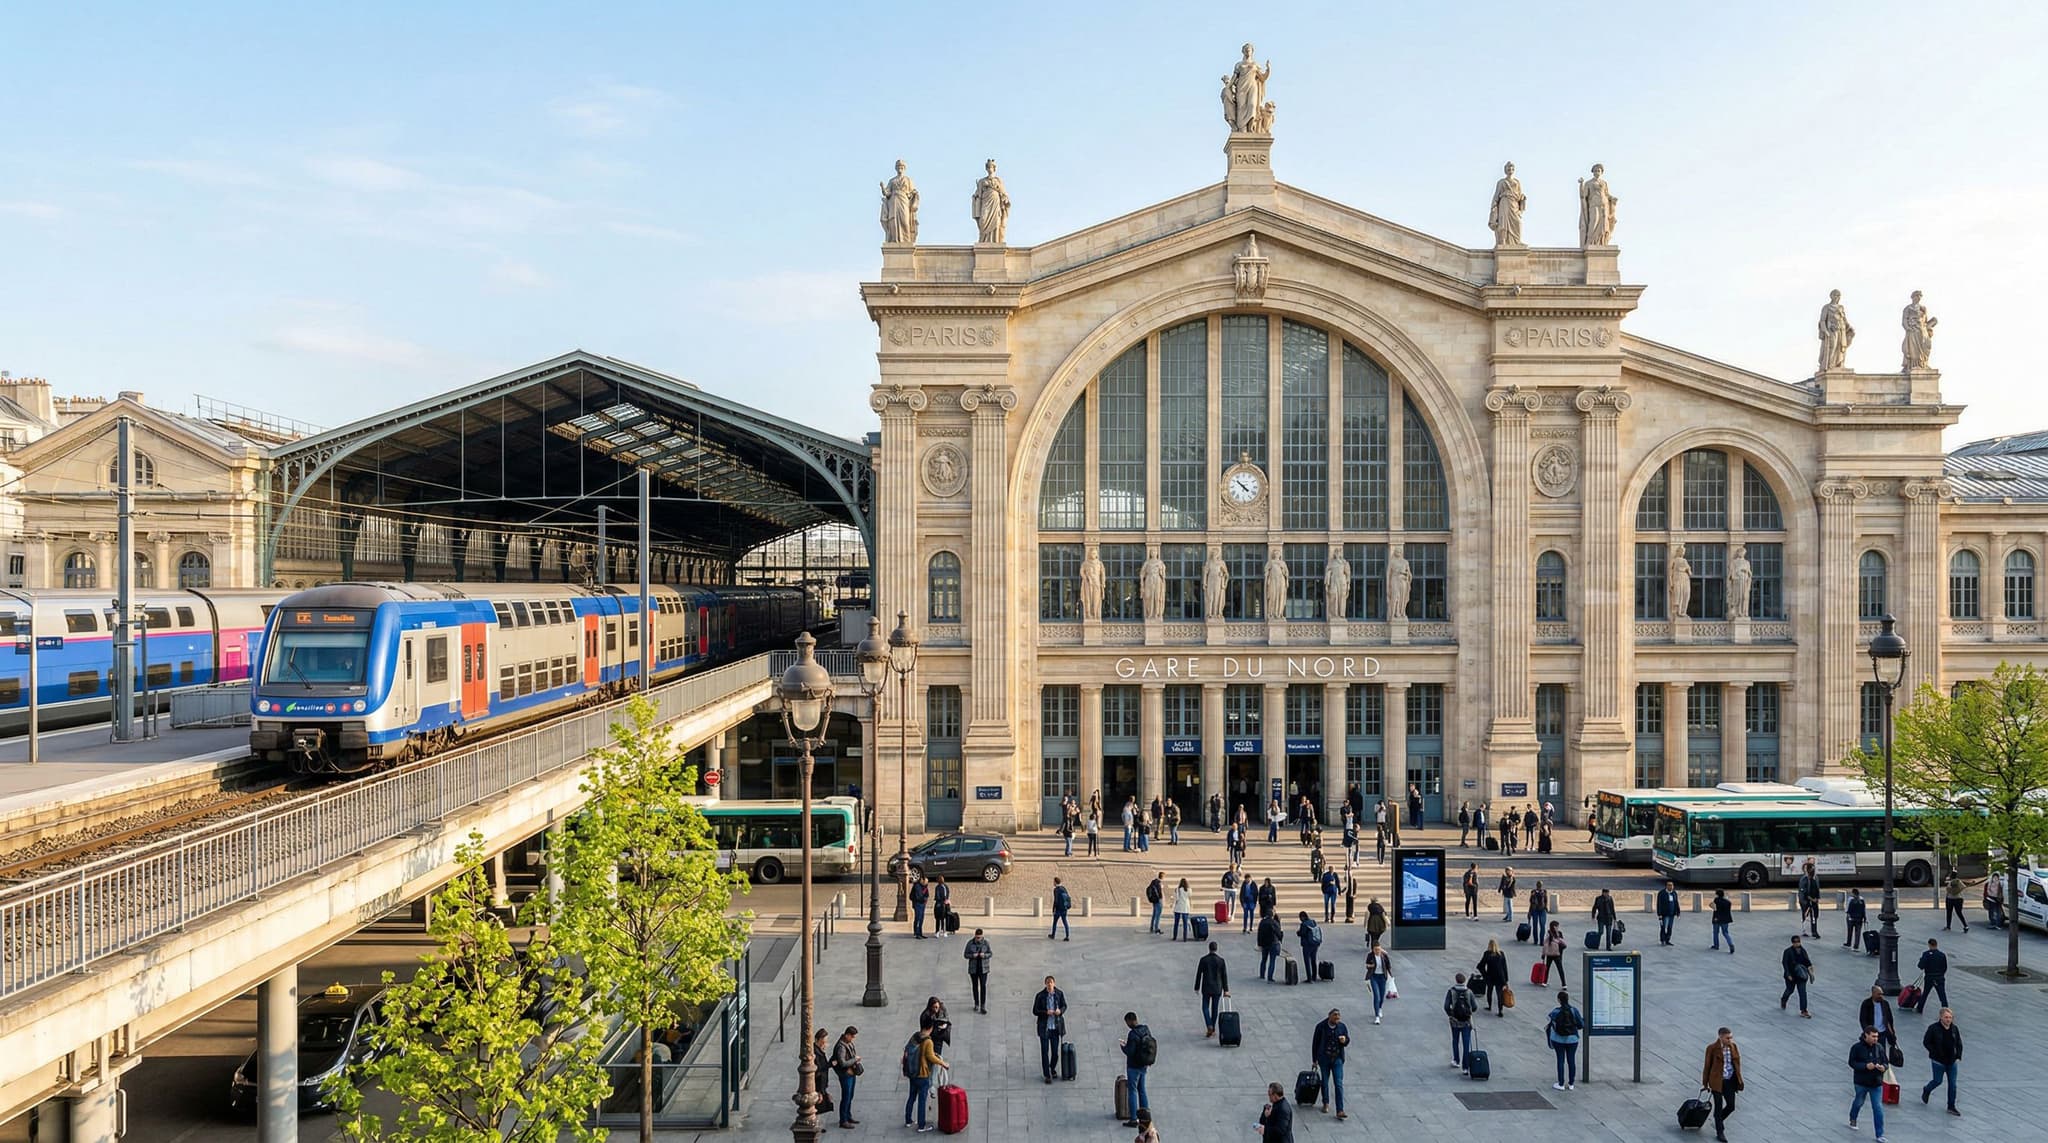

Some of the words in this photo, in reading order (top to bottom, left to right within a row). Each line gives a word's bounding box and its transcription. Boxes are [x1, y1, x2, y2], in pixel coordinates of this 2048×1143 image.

[1234, 153, 1267, 165] PARIS
[910, 326, 977, 346] PARIS
[1525, 327, 1592, 348] PARIS
[1115, 657, 1200, 678] GARE
[1223, 657, 1263, 678] DU
[1288, 656, 1381, 678] NORD
